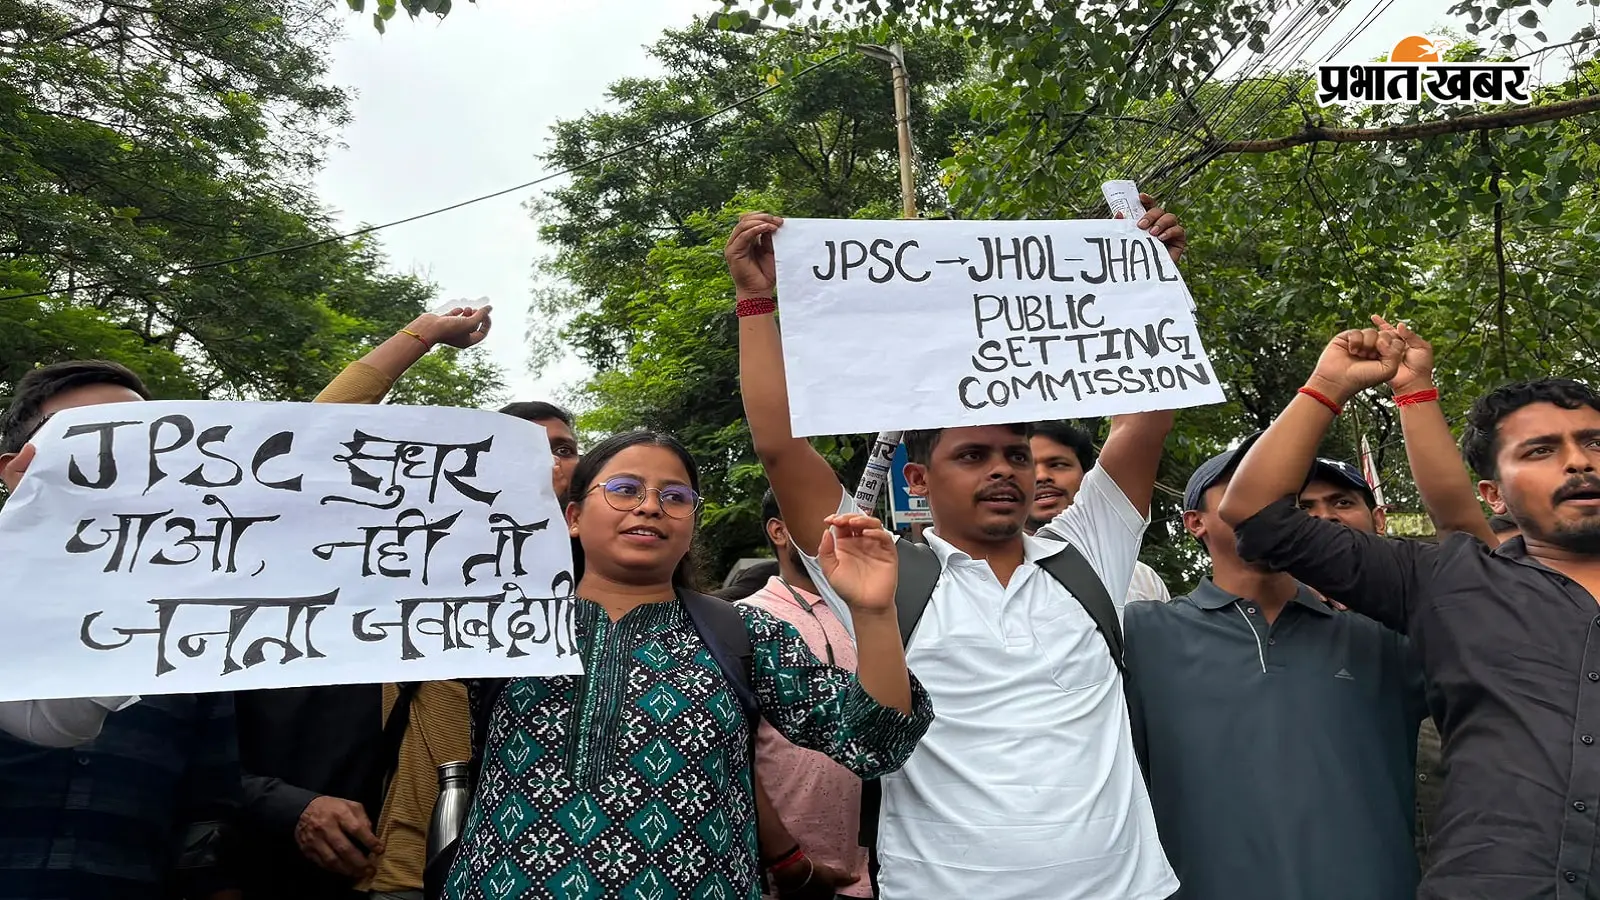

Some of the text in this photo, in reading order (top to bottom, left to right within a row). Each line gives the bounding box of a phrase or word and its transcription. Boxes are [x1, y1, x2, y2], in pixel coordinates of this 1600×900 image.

[812, 239, 932, 283] JPSC
[974, 293, 1105, 338] PUBLIC
[971, 317, 1196, 373] SETTING
[958, 362, 1211, 410] COMMISSION
[62, 414, 502, 510] JPSC सुधर
[461, 512, 550, 587] तो
[80, 587, 340, 676] जनता
